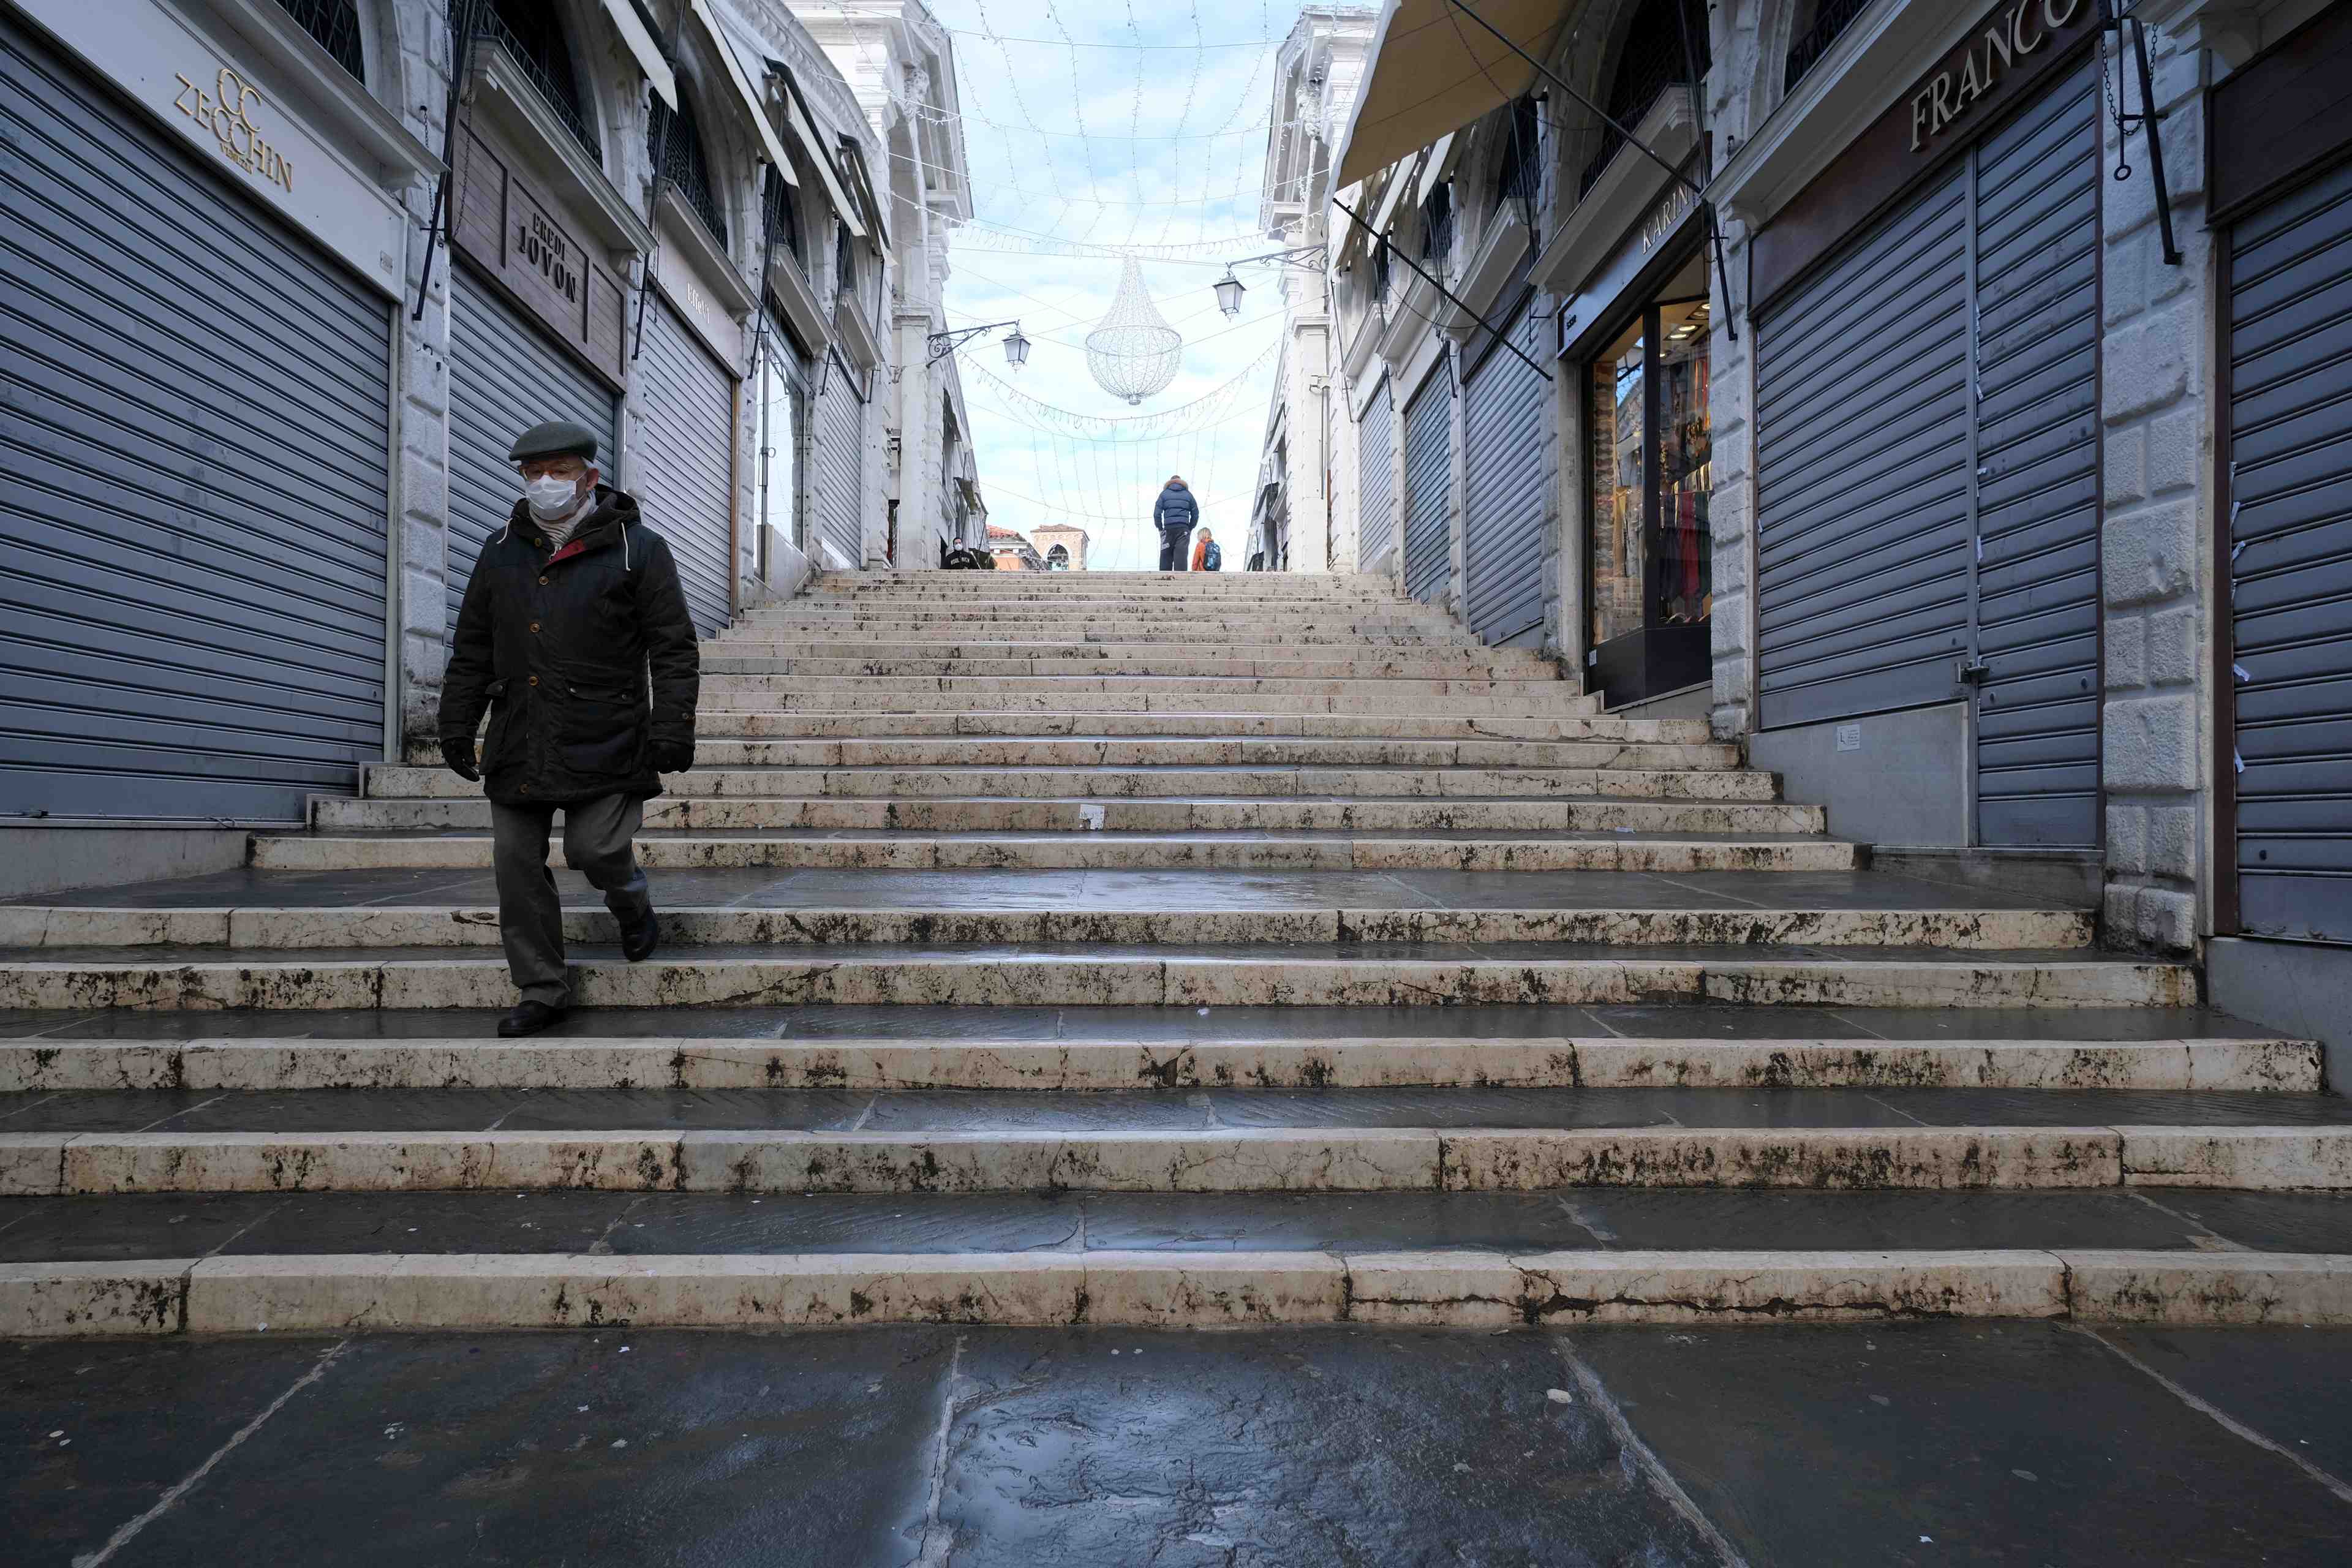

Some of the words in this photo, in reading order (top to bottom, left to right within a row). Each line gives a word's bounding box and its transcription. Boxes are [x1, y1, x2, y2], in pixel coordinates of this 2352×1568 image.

[174, 72, 294, 193] ZECCHIN
[533, 213, 565, 262] EREDI
[1643, 184, 1689, 255] KARIN
[519, 226, 576, 303] JOVON
